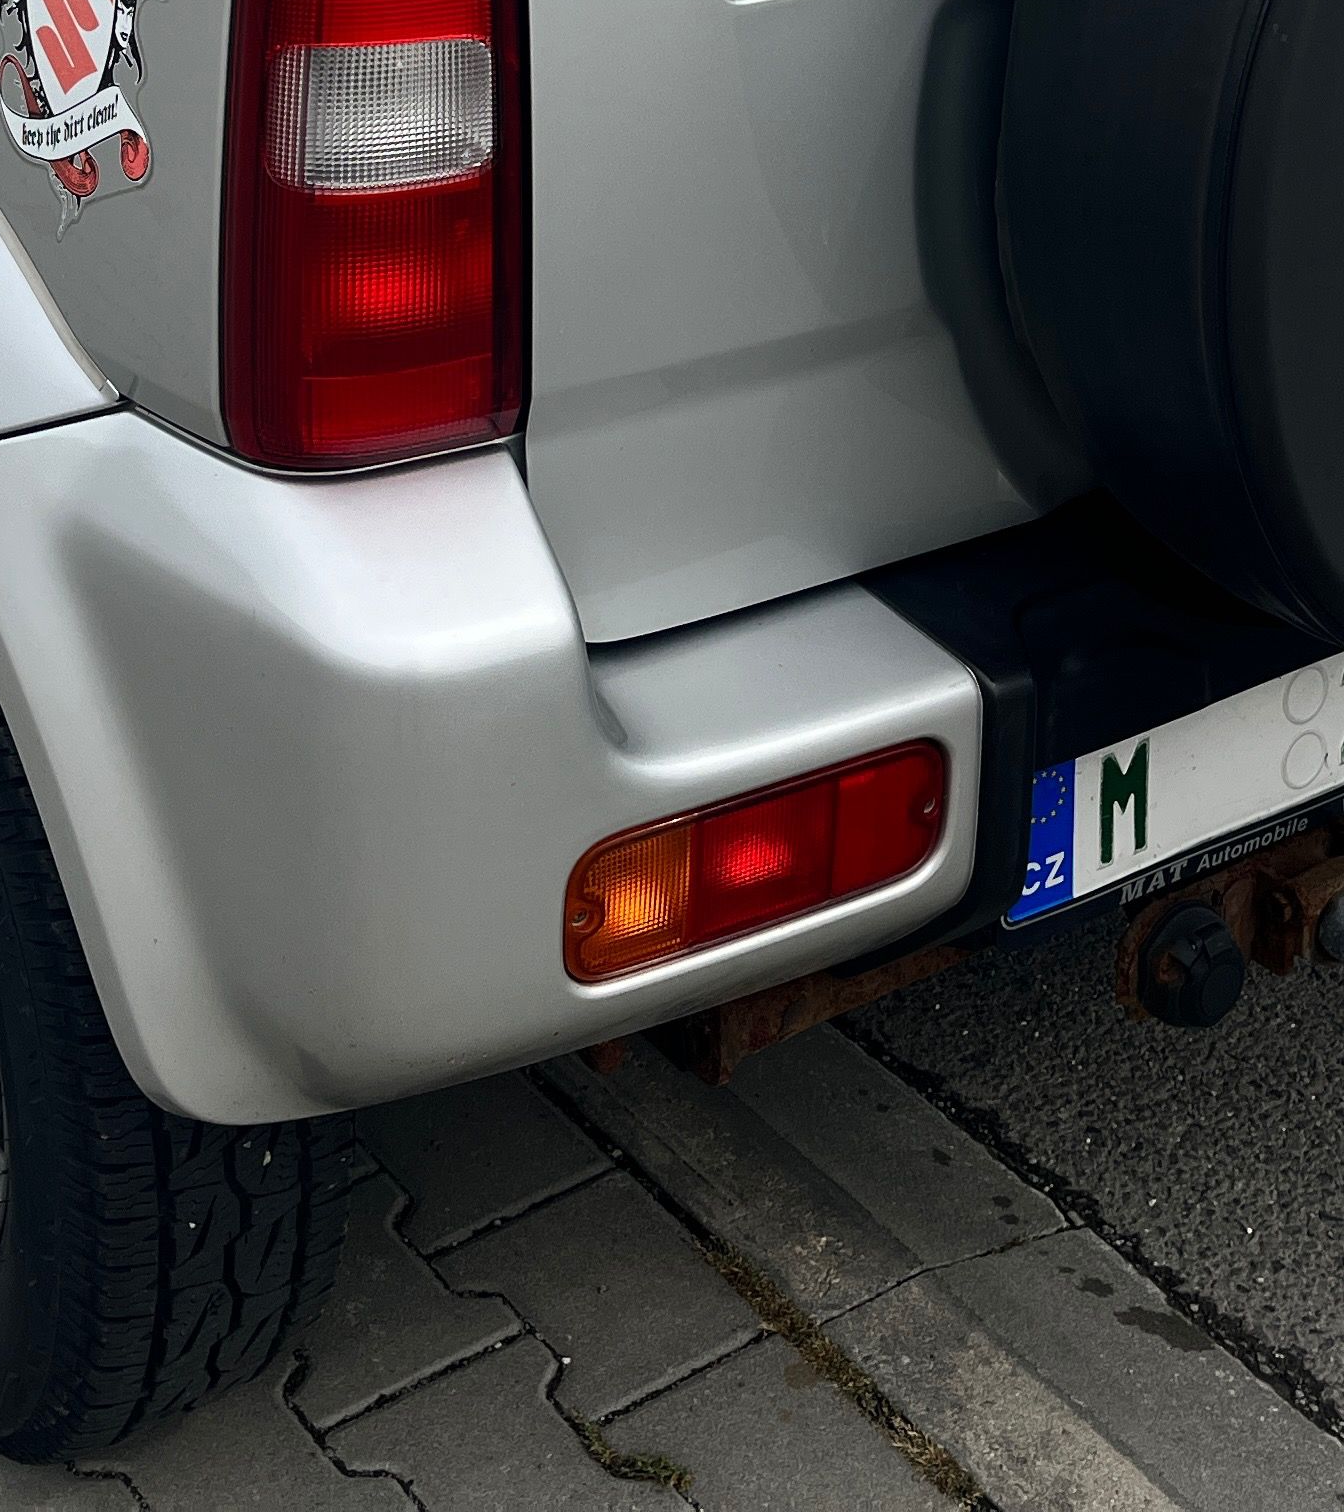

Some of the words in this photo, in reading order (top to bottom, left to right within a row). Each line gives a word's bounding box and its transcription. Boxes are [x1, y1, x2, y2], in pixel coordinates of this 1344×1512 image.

[22, 122, 43, 151] keep
[46, 123, 61, 151] the
[64, 115, 84, 142] dirt
[87, 94, 118, 131] clean!
[1098, 737, 1150, 870] M
[1022, 851, 1064, 896] CZ
[1119, 857, 1189, 905] MAT
[1196, 817, 1308, 872] Automobile
